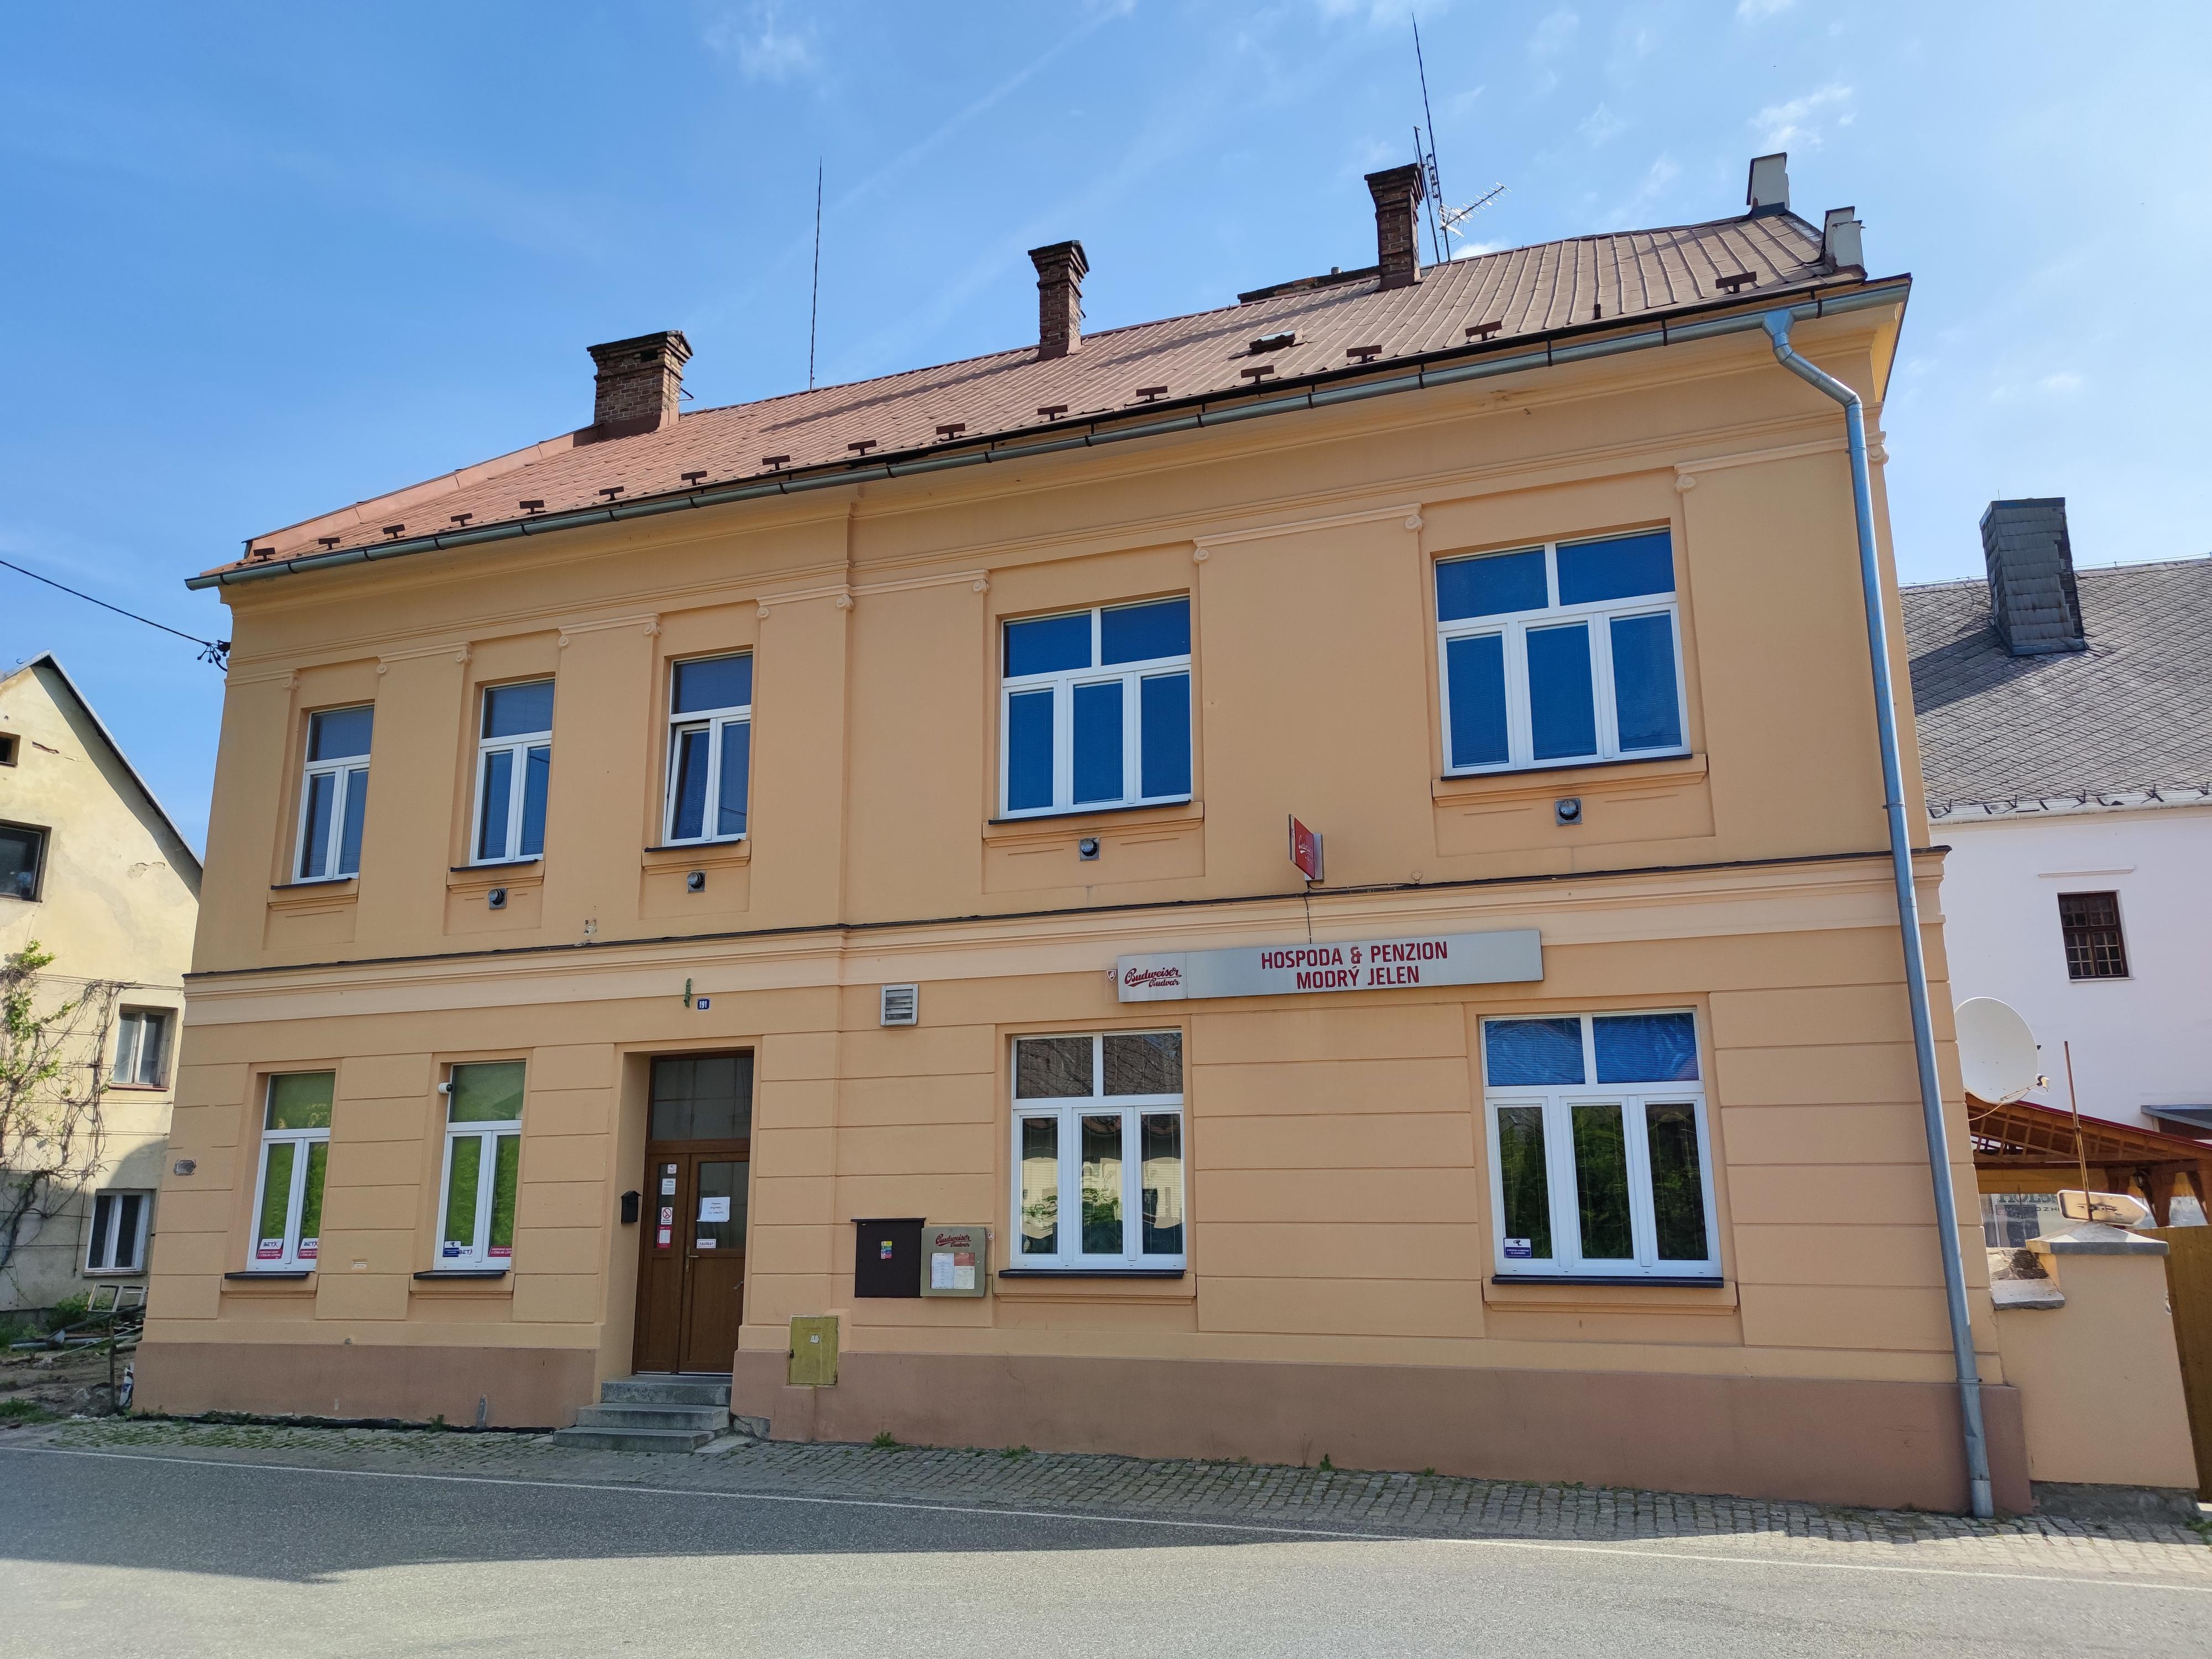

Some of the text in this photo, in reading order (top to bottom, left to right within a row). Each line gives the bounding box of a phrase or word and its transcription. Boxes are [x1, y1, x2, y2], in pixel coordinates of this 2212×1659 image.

[1261, 941, 1448, 969] HOSPODA & PENZION
[1124, 967, 1182, 985] Budweiser
[1149, 978, 1181, 988] Budvar
[1296, 965, 1420, 989] MODRÝ JELEN
[936, 1233, 972, 1245] Budweiser
